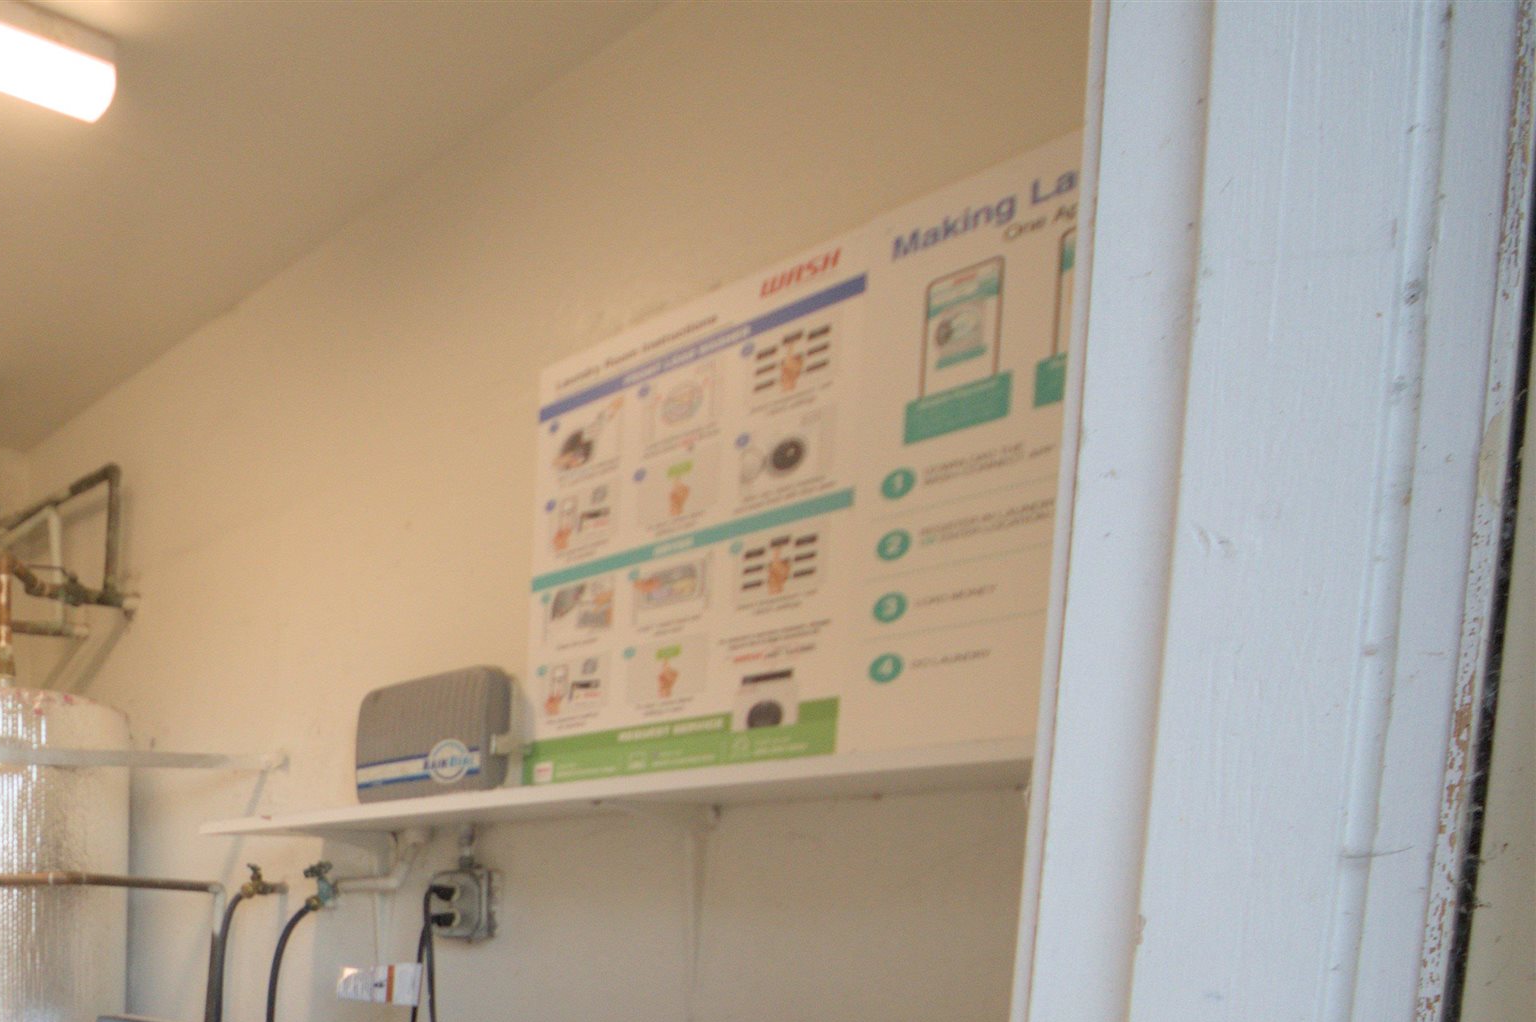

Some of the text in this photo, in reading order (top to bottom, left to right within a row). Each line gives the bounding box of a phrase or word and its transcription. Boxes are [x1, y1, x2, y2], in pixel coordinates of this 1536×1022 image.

[891, 193, 1017, 262] Making
[1003, 215, 1048, 243] One
[758, 247, 841, 299] WASH
